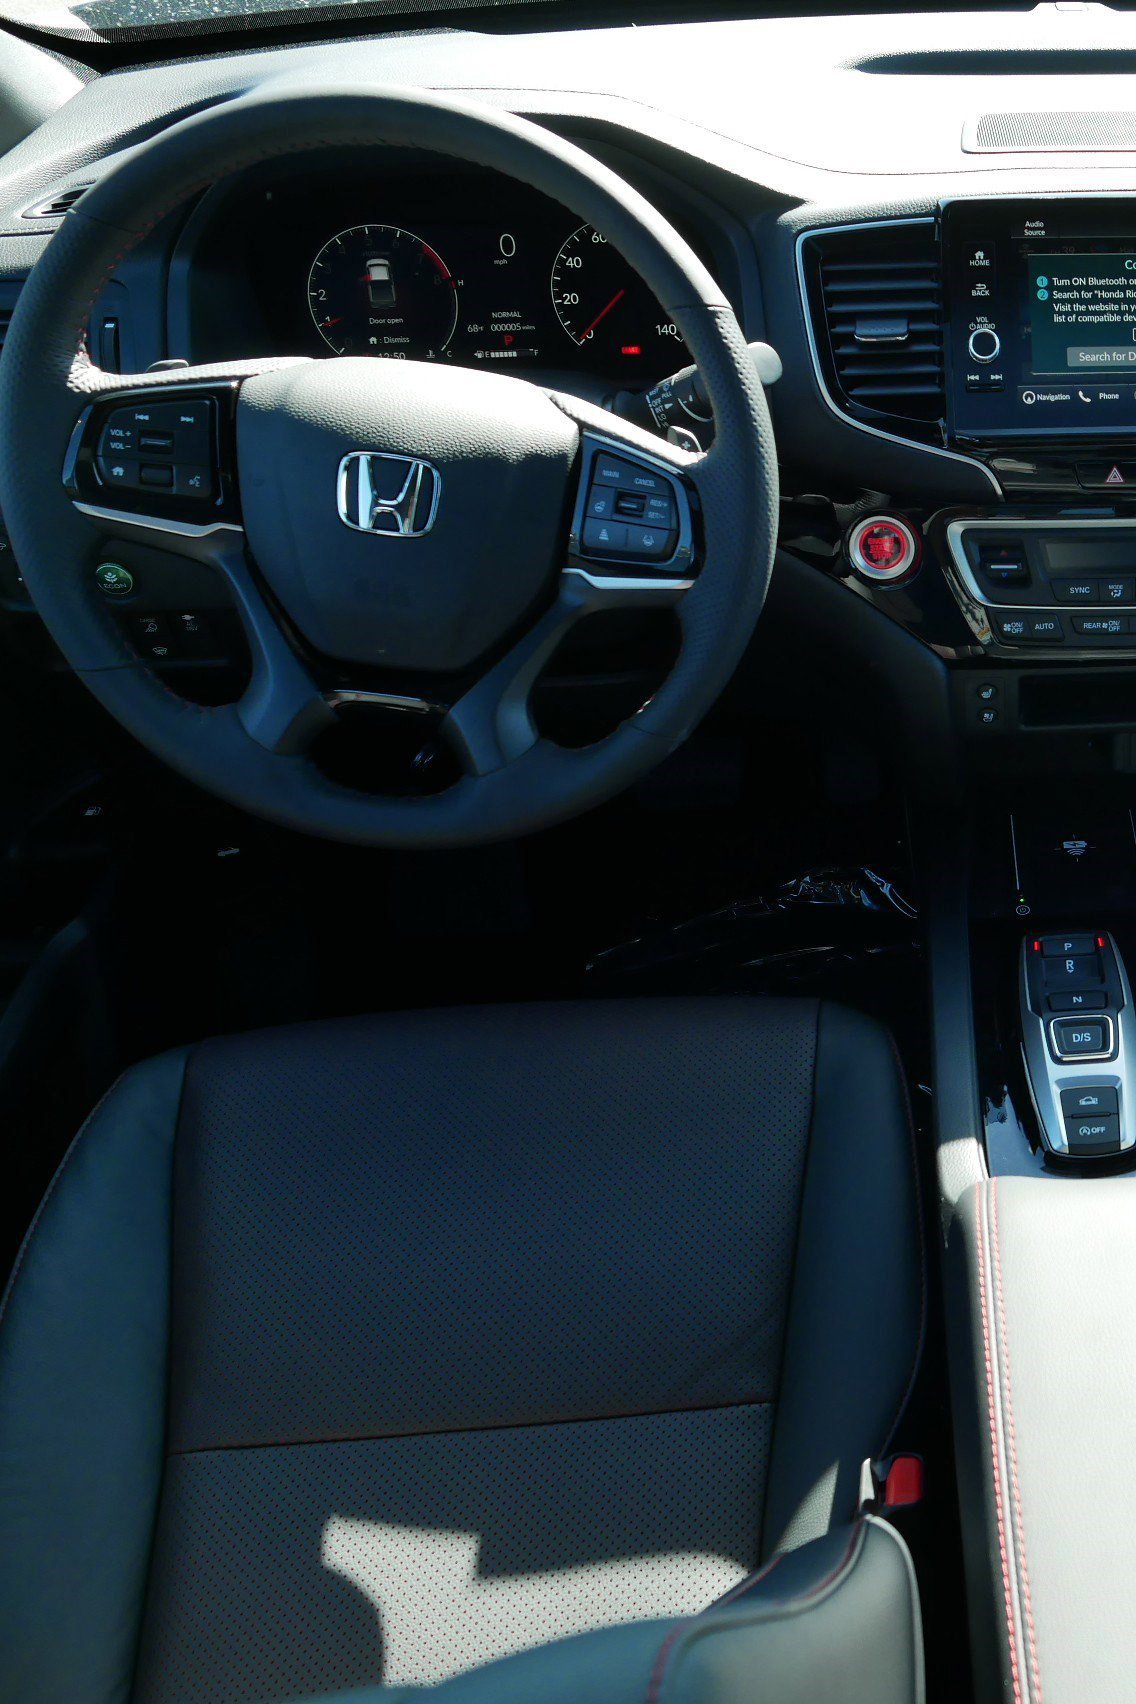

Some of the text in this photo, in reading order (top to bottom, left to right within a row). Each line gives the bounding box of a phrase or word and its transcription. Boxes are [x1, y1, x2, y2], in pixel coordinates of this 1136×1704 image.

[500, 234, 516, 256] 0
[566, 256, 582, 268] 40
[1052, 278, 1070, 286] Turn
[1072, 278, 1086, 286] ON
[1088, 276, 1127, 286] Bluetooth
[318, 289, 326, 300] 2
[562, 293, 579, 305] 20
[1052, 290, 1080, 299] Search
[1081, 290, 1093, 299] for
[1094, 290, 1124, 299] "Honda
[1053, 303, 1071, 311] Visit
[1073, 303, 1086, 311] the
[1088, 302, 1119, 311] website
[1121, 302, 1128, 310] in
[386, 318, 404, 326] open
[1053, 313, 1066, 322] list
[1067, 313, 1077, 322] of
[1078, 313, 1121, 323] compatible
[655, 324, 677, 336] 140
[1079, 352, 1110, 361] Search
[1112, 352, 1126, 361] for
[1037, 393, 1070, 401] Navigation
[1070, 586, 1090, 594] SYNC
[1064, 942, 1072, 951] P
[1066, 960, 1074, 970] R
[1072, 1032, 1091, 1043] D/S
[1091, 1126, 1106, 1134] OFF
